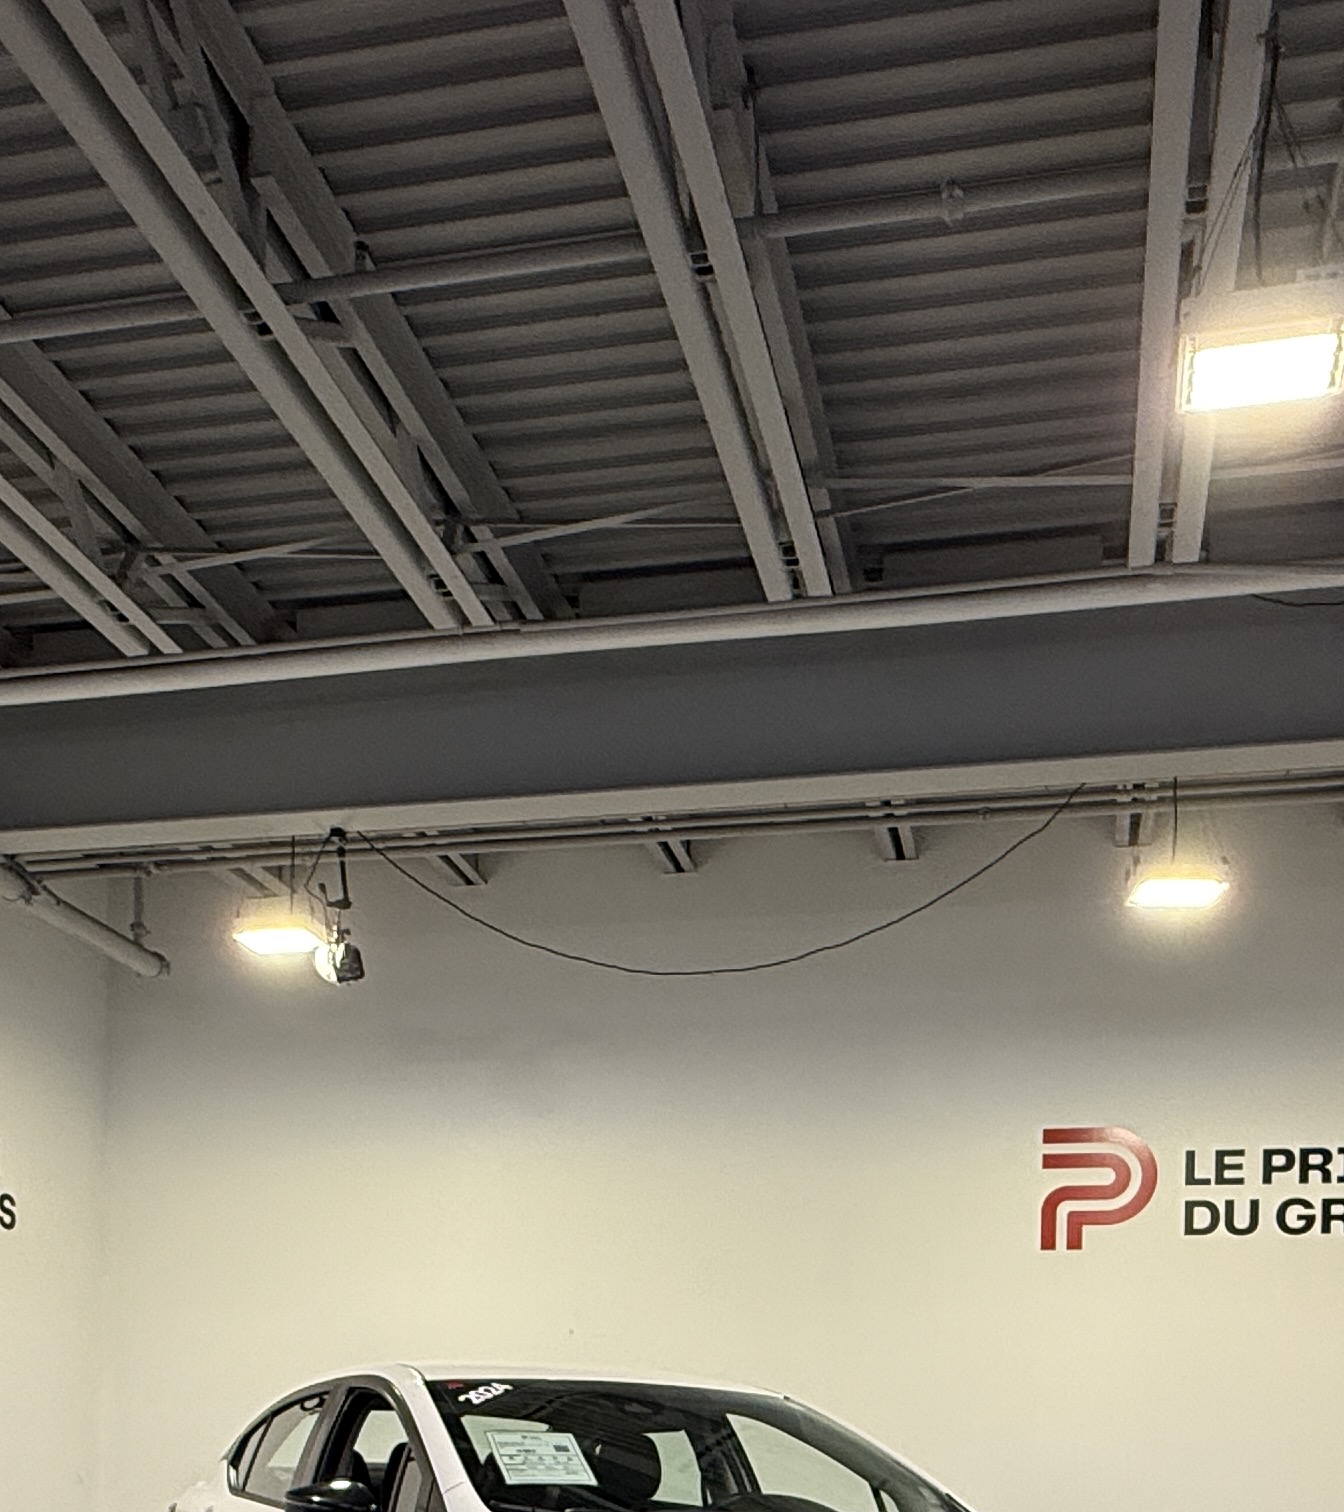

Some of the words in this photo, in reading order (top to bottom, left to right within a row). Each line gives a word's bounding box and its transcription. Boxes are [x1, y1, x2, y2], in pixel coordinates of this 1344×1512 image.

[1184, 1149, 1246, 1186] LE
[1183, 1198, 1260, 1236] DU
[458, 1382, 514, 1405] 2024
